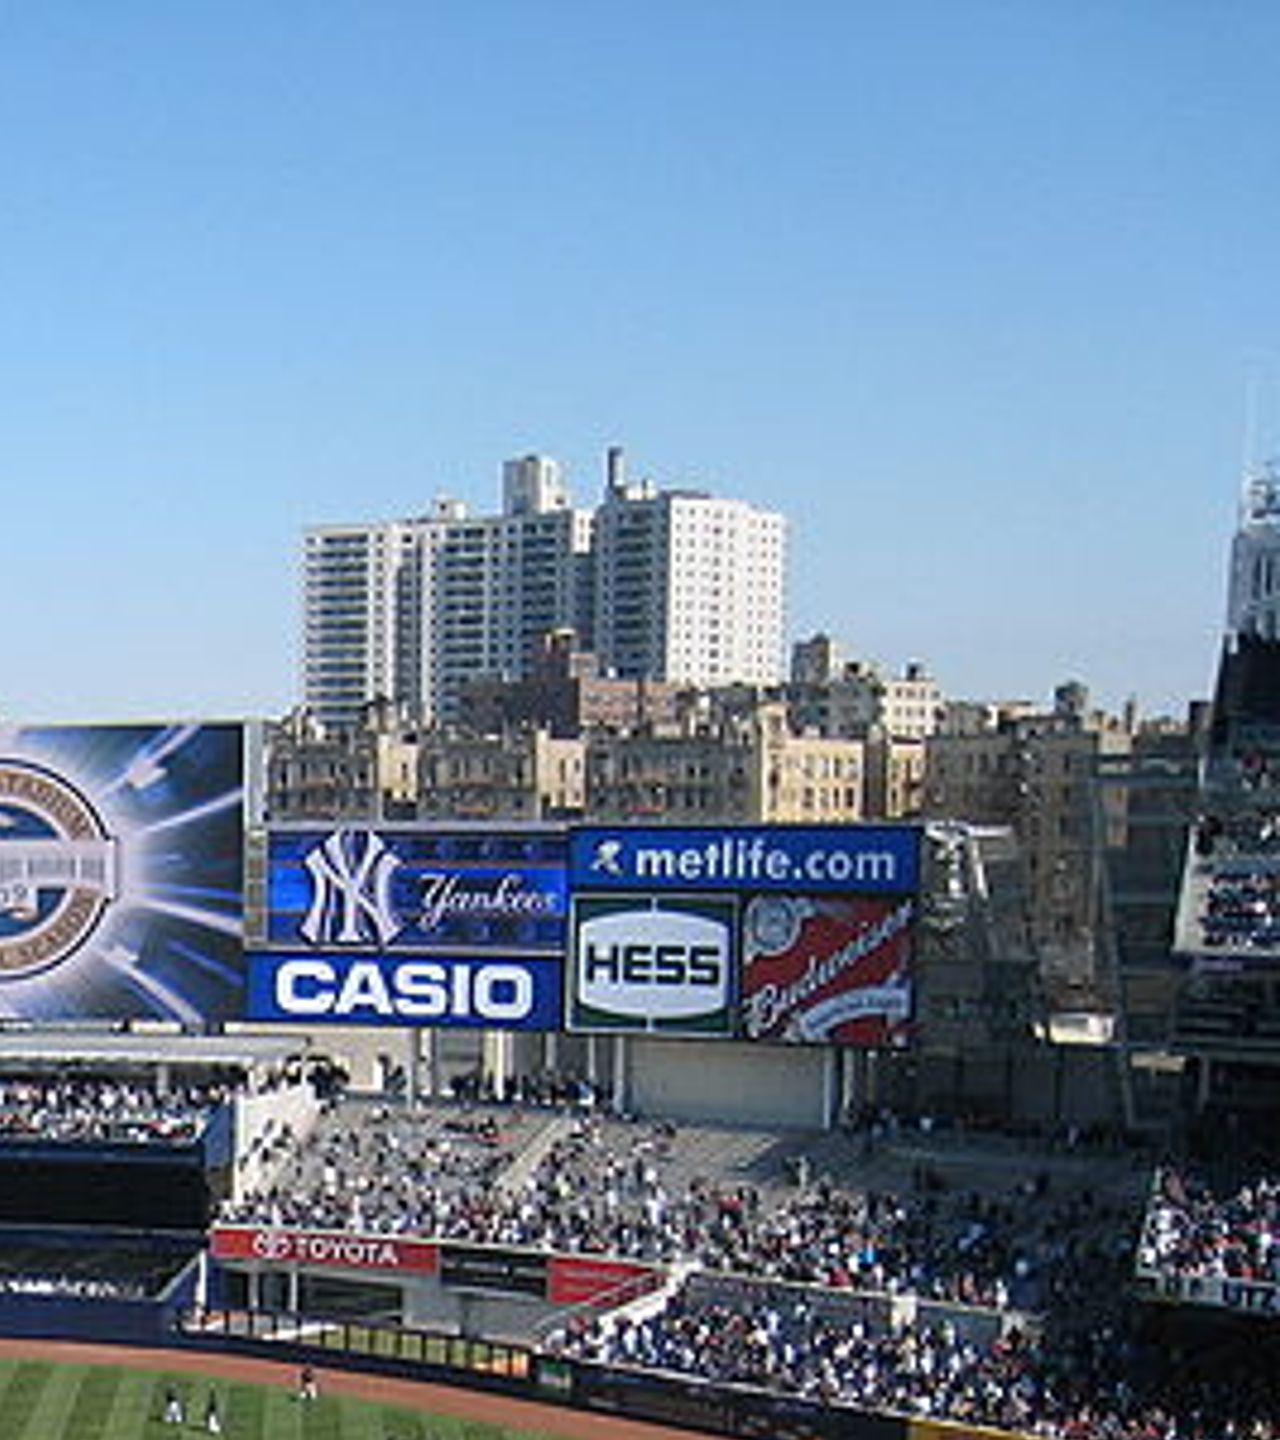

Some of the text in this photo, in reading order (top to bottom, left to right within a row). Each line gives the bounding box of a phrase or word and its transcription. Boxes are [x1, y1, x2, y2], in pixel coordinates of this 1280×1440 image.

[635, 839, 896, 880] metlife.com
[418, 873, 557, 931] Yankees
[586, 945, 721, 985] HESS
[276, 960, 533, 1019] CASIO
[297, 1238, 399, 1265] TOYOTA
